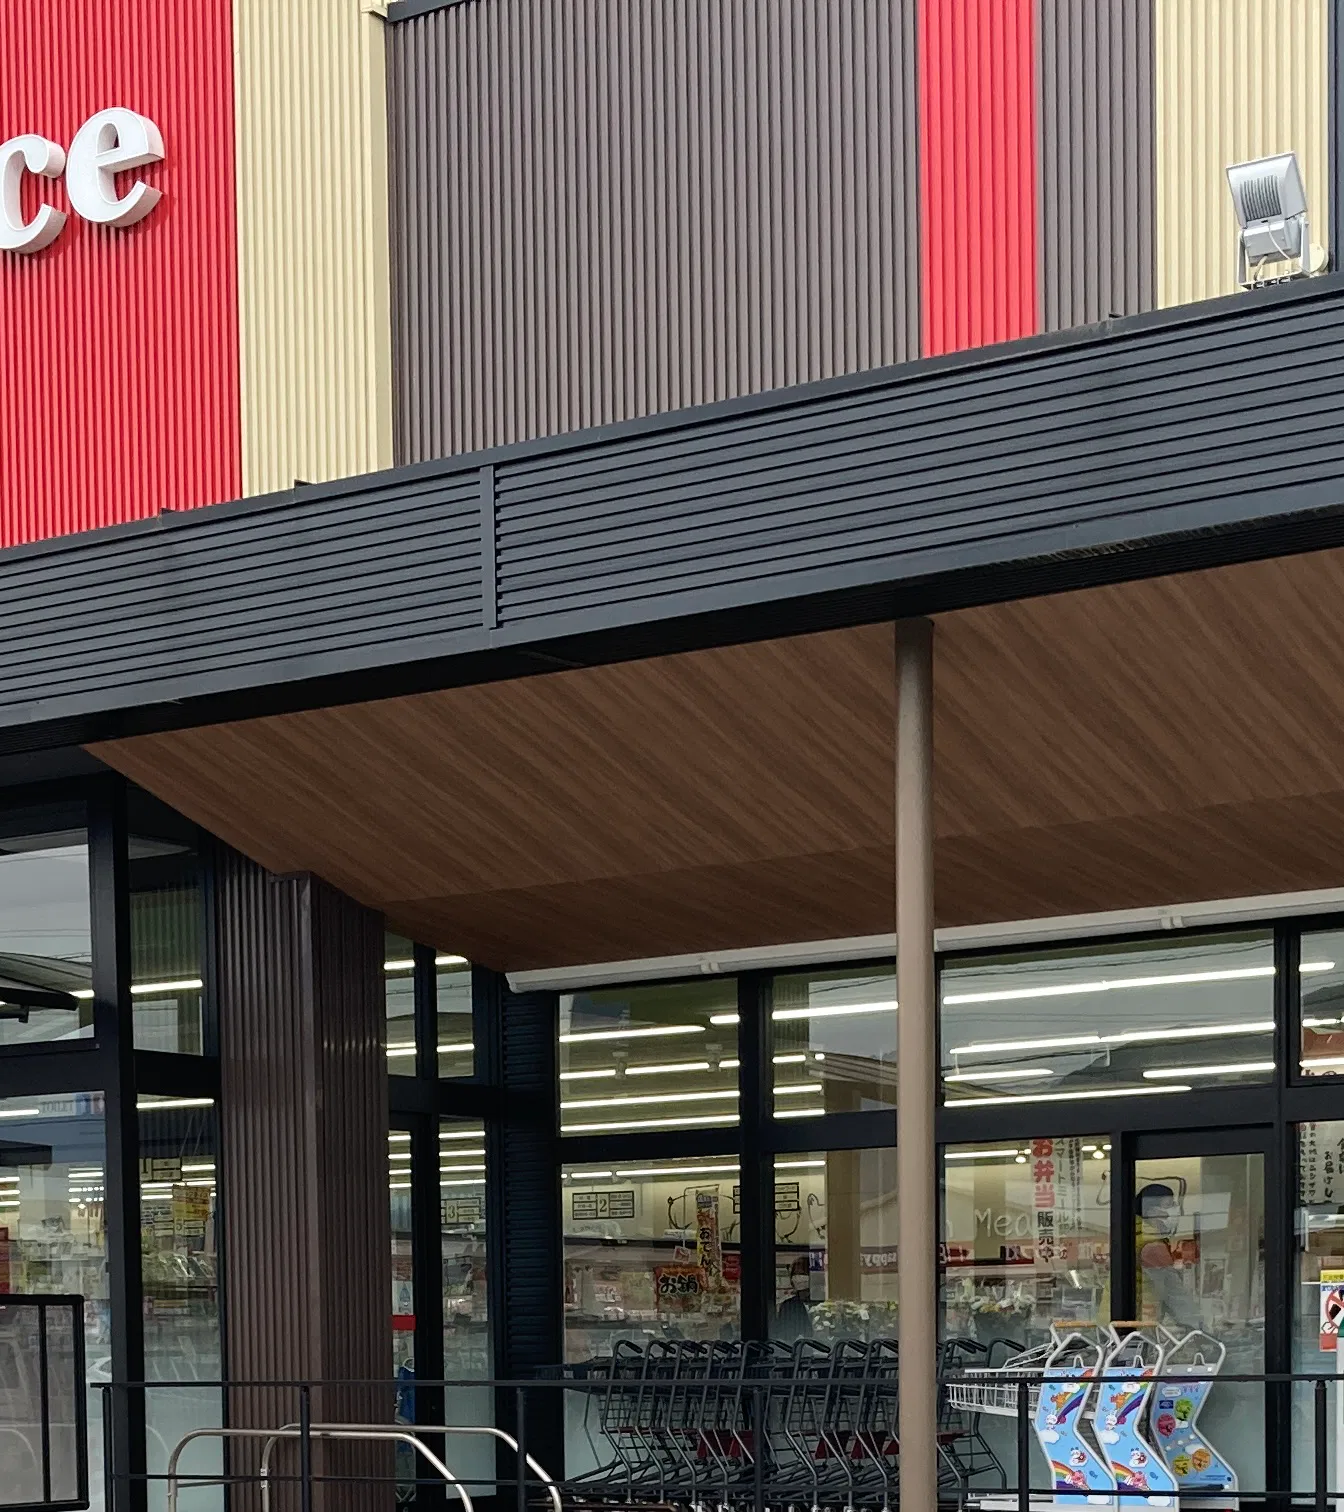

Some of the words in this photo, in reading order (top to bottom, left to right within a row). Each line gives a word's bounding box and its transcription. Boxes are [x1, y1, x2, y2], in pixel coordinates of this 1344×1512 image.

[599, 1198, 608, 1213] 2
[1032, 1138, 1055, 1263] お弁当販売中
[447, 1204, 456, 1219] 3
[658, 1273, 699, 1295] お鍋
